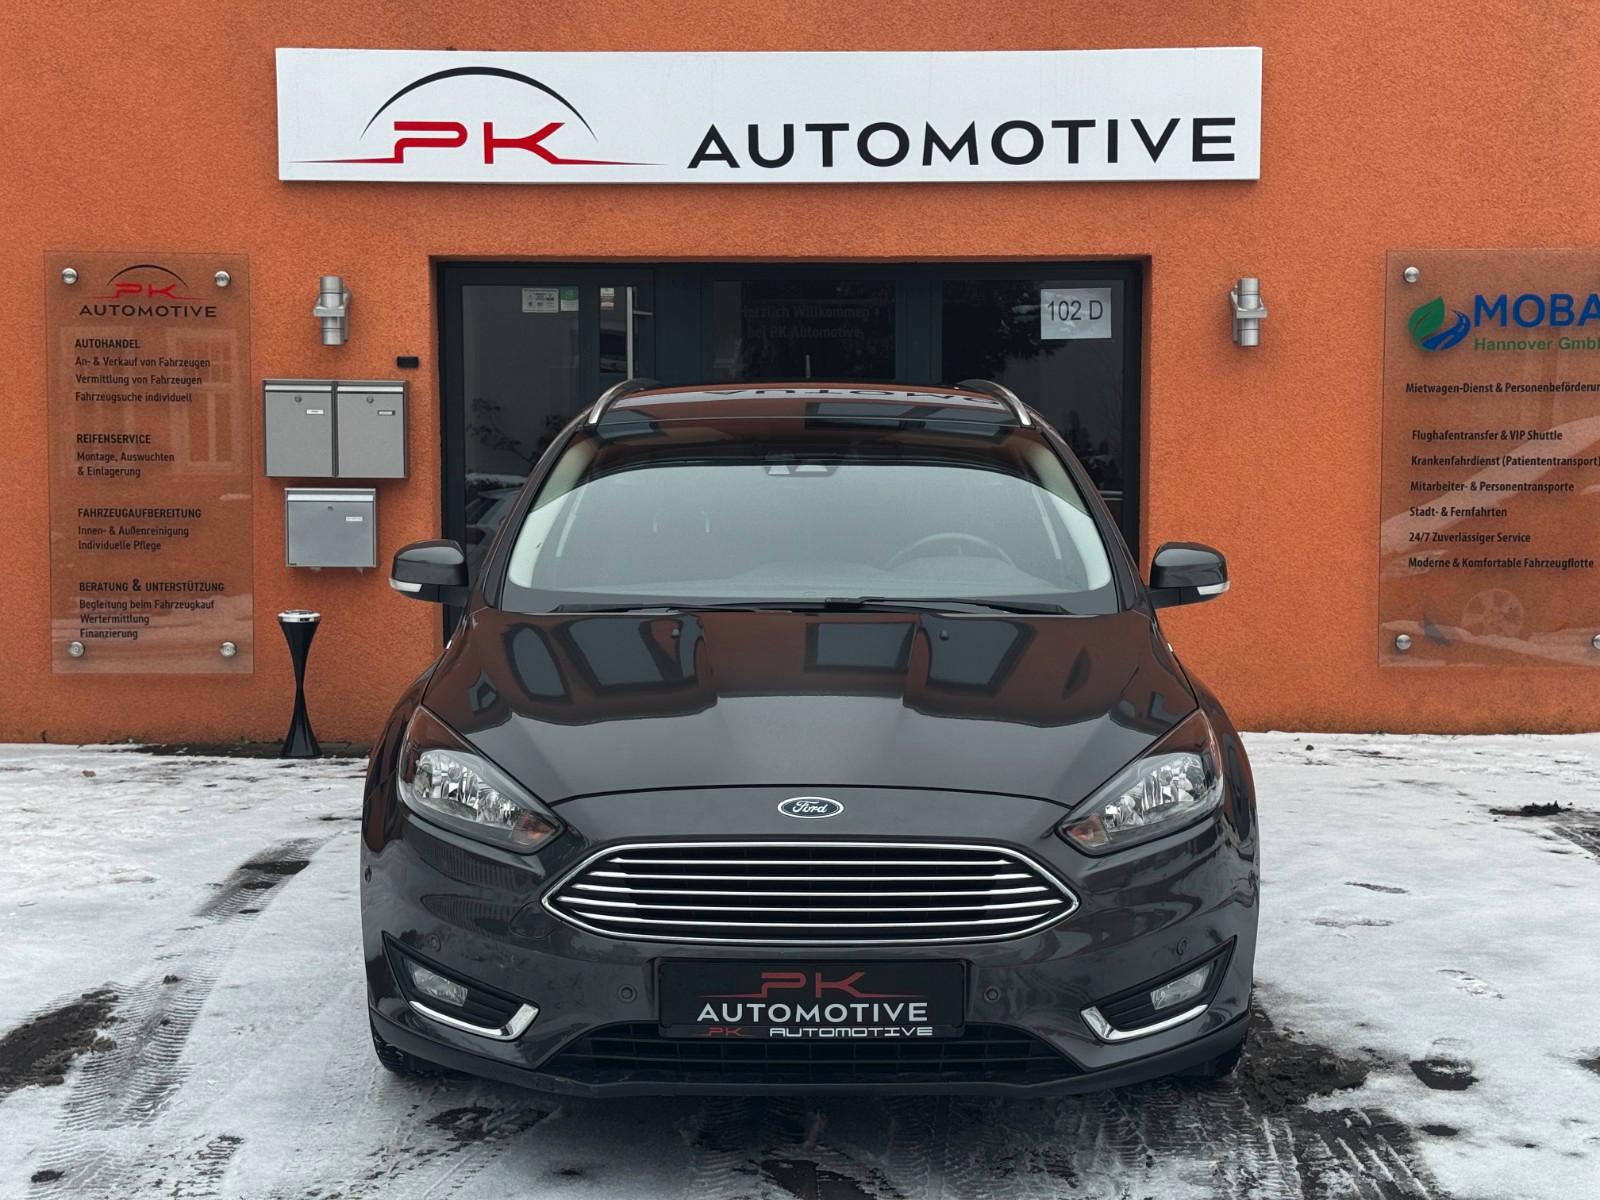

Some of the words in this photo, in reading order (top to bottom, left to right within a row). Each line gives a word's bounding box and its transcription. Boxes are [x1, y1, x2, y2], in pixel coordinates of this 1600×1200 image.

[391, 120, 568, 165] PK
[687, 116, 1236, 171] AUTOMOTIVE
[115, 282, 178, 298] PK
[79, 304, 217, 318] AUTOMOTIVE
[1047, 300, 1082, 322] 102
[1089, 300, 1103, 321] D
[1473, 293, 1600, 328] MOBA
[75, 338, 141, 349] AUTOHANDEL
[1474, 336, 1552, 351] Hannover
[1558, 336, 1600, 350] Gmb
[75, 356, 91, 367] An-
[93, 357, 100, 367] &
[102, 356, 138, 367] Verkauf
[140, 358, 157, 367] von
[158, 357, 211, 370] Fahrzeugen
[75, 374, 129, 386] Vermittlung
[131, 376, 148, 386] von
[150, 374, 203, 388] Fahrzeugen
[1405, 382, 1494, 396] Mietwagen-Dienst
[1495, 383, 1503, 393] &
[75, 391, 143, 404] Fahrzeugsuche
[145, 392, 193, 403] individuell
[76, 433, 151, 445] REIFENSERVICE
[1412, 429, 1499, 442] Flughafentransfer
[1500, 430, 1508, 441] &
[1509, 430, 1526, 441] VIP
[1527, 429, 1563, 441] Shuttle
[77, 451, 119, 464] Montage,
[120, 452, 175, 463] Auswuchten
[1411, 455, 1501, 466] Krankenfahrdienst
[77, 466, 85, 476] &
[86, 466, 141, 478] Einlagerung
[1410, 480, 1468, 492] Mitarbeiter-
[1469, 481, 1477, 492] &
[1479, 481, 1575, 494] Personentransporte
[78, 507, 202, 519] FAHRZEUGAUFBEREITUNG
[1409, 506, 1439, 517] Stadt-
[1440, 506, 1449, 517] &
[1450, 506, 1508, 517] Fernfahrten
[78, 525, 107, 536] Innen-
[108, 526, 116, 536] &
[118, 525, 189, 538] Außenreinigung
[1408, 531, 1431, 543] 24/7
[1432, 531, 1495, 545] Zuverlässiger
[1496, 532, 1531, 543] Service
[78, 540, 131, 551] Individuelle
[133, 541, 162, 552] Pflege
[1408, 556, 1451, 568] Moderne
[1452, 557, 1460, 568] &
[1461, 557, 1522, 569] Komfortable
[1523, 557, 1595, 571] Fahrzeugflotte
[79, 581, 129, 592] BERATUNG
[132, 578, 142, 592] &
[145, 580, 225, 592] UNTERSTÜTZUNG
[79, 600, 128, 611] Begleitung
[129, 600, 152, 610] beim
[154, 599, 215, 611] Fahrzeugkauf
[79, 614, 150, 626] Wertermittlung
[79, 628, 139, 641] Finanzierung
[792, 800, 829, 813] Ford
[761, 972, 865, 998] PK
[696, 1002, 929, 1023] AUTOMOTIVE
[708, 1027, 743, 1037] PK
[769, 1026, 934, 1038] AUTOMOTIVE
